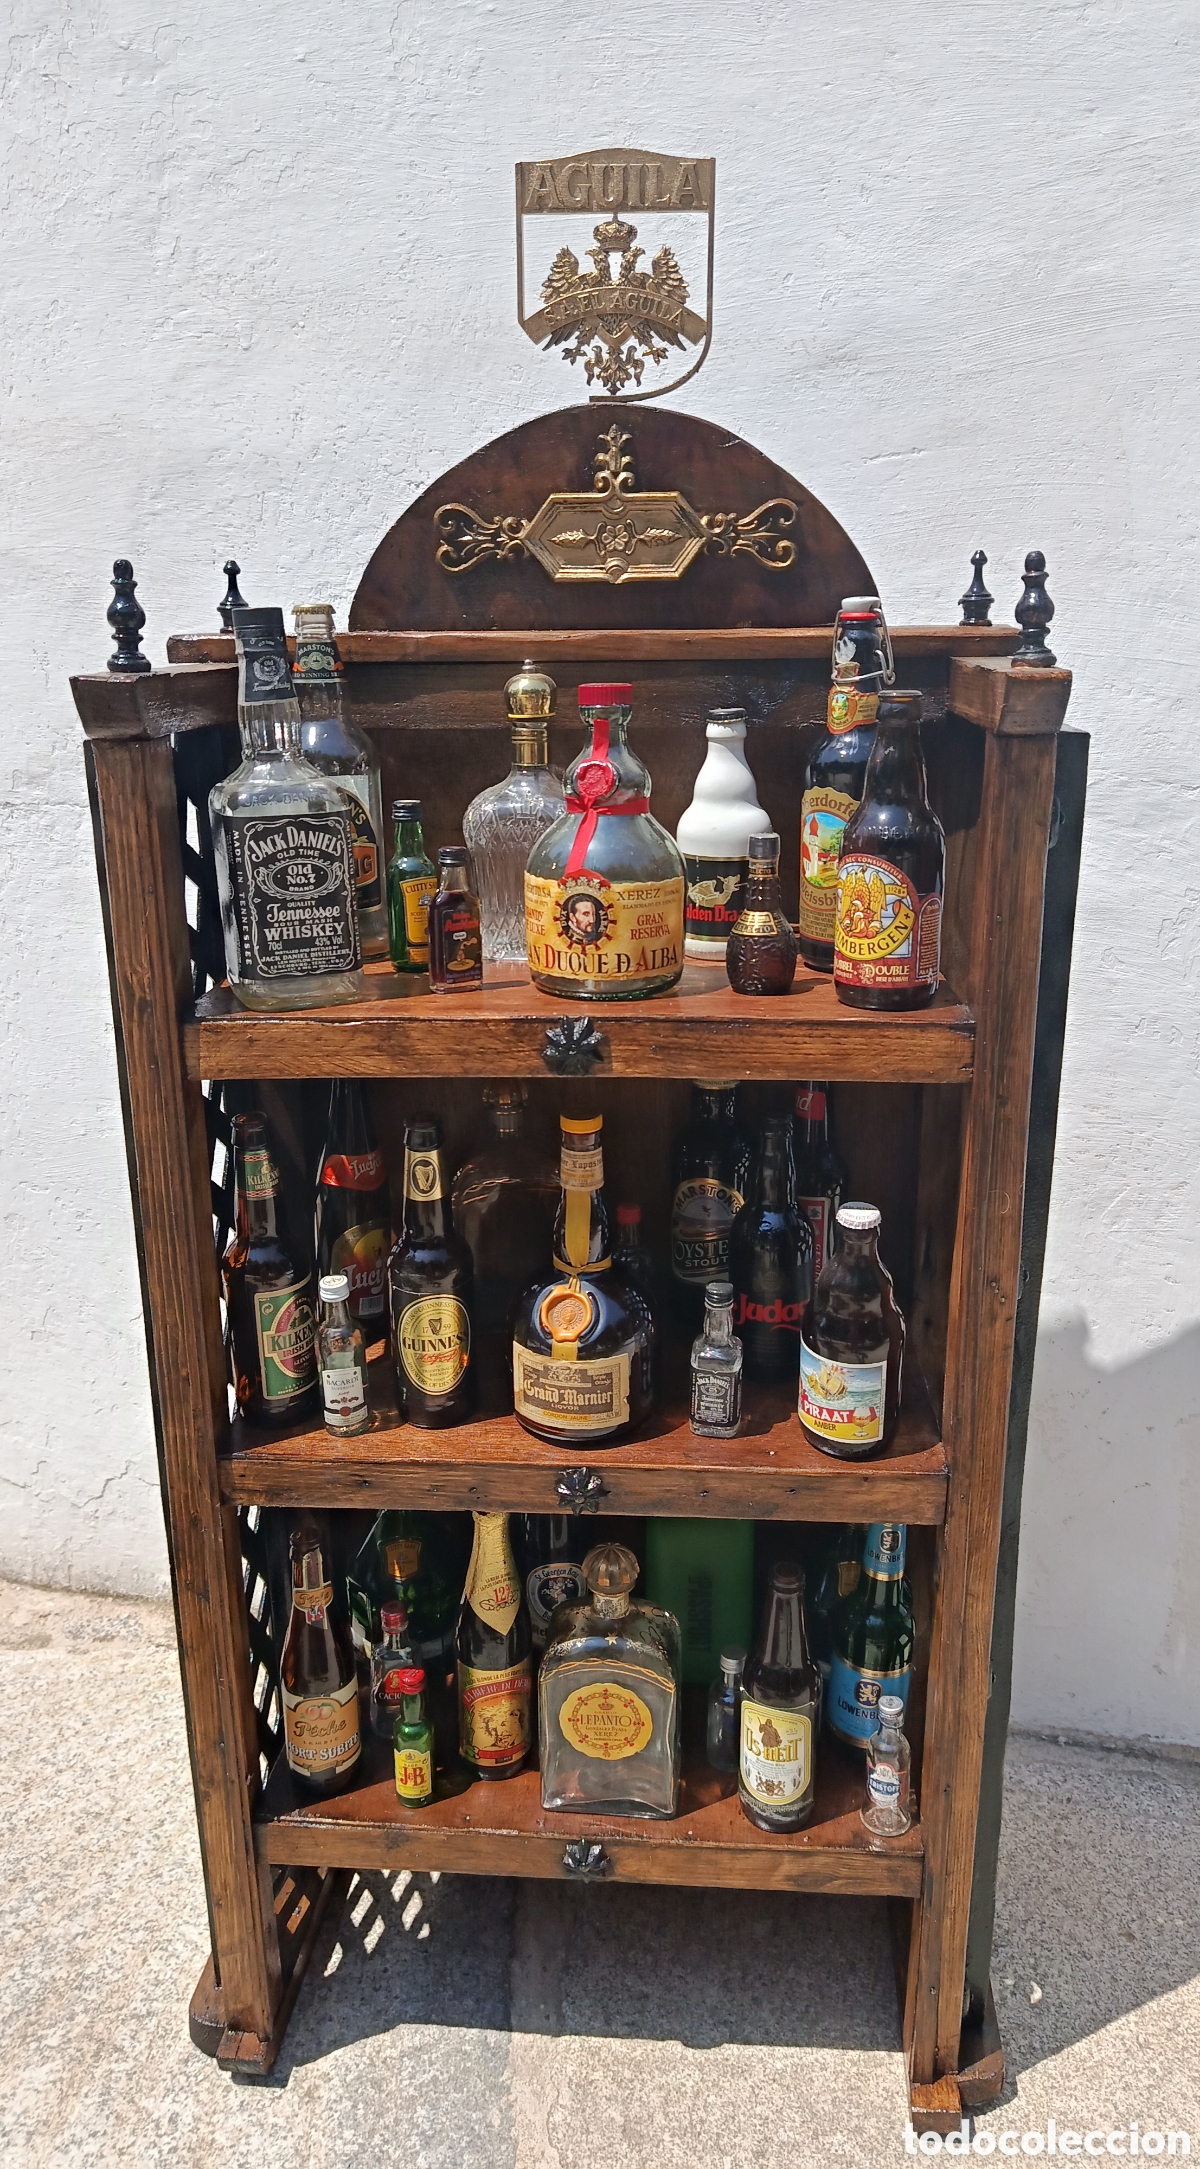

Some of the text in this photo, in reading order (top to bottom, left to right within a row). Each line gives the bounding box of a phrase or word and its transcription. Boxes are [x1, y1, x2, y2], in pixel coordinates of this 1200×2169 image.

[524, 161, 708, 208] AGUILA
[577, 294, 605, 318] EL
[610, 293, 683, 329] AGUILA
[298, 643, 335, 656] MARSTON'S
[249, 831, 284, 863] JACK
[286, 826, 345, 857] DANIEL'S
[276, 848, 320, 859] OLD TIME
[287, 864, 313, 875] Old
[857, 856, 904, 880] CONSUMITUR
[405, 882, 427, 894] CUTTY
[616, 888, 661, 901] XEREZ
[887, 886, 902, 895] 1128
[232, 830, 253, 966] MADE IN TENNESSEE
[287, 900, 316, 908] QUALITY
[266, 903, 341, 923] Tennessee
[636, 912, 664, 927] GRAN
[263, 921, 345, 941] WHISKEY
[630, 924, 671, 941] RESERVA
[734, 924, 771, 934] SELECTO
[267, 941, 283, 951] 70cl
[315, 936, 331, 946] 43%
[282, 953, 310, 961] DANIEL
[543, 943, 609, 975] DUQUE
[636, 943, 679, 973] ALBA
[675, 1184, 742, 1216] MARSTON'S
[685, 1256, 728, 1268] STOUT
[418, 1302, 452, 1313] GUINNESS
[422, 1326, 429, 1334] 17
[283, 1344, 304, 1358] IRISH
[326, 1376, 360, 1386] BACARDI
[524, 1379, 613, 1406] Grand Marnier
[543, 1411, 568, 1420] CORDON
[803, 1400, 850, 1423] PIRAAT
[813, 1419, 837, 1431] AMBER
[534, 1573, 544, 1582] St.
[542, 1567, 567, 1579] Georgen
[579, 1714, 632, 1728] LEPANTO
[303, 1736, 339, 1746] LAMBIC
[869, 1778, 901, 1794] ERISTOFF
